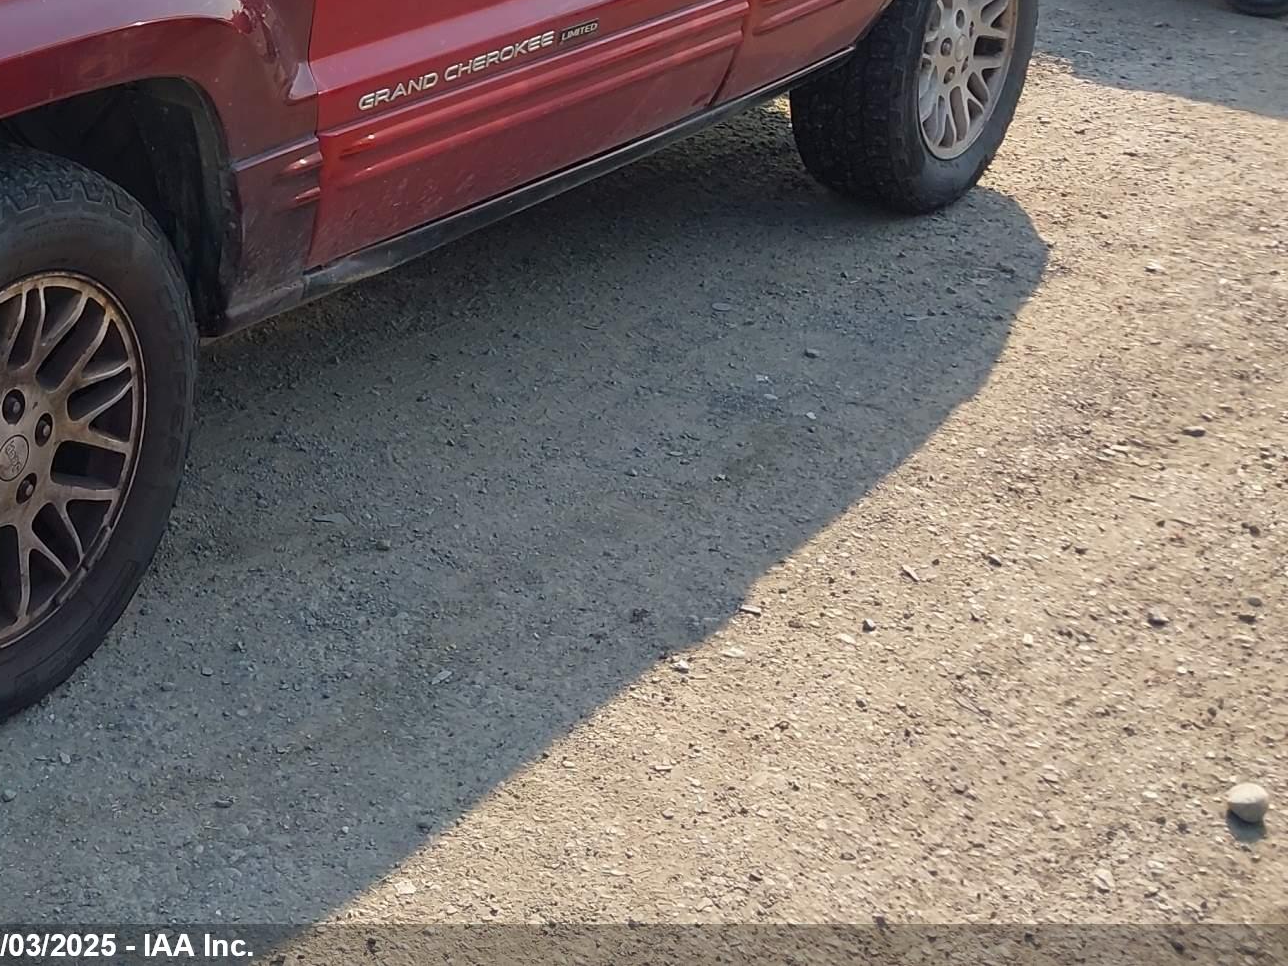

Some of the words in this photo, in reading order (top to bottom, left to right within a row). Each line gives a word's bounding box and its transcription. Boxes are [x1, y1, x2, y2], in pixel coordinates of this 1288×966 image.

[358, 72, 438, 111] GRAND
[444, 30, 555, 82] CHEROKEE
[562, 21, 599, 42] LIMITED
